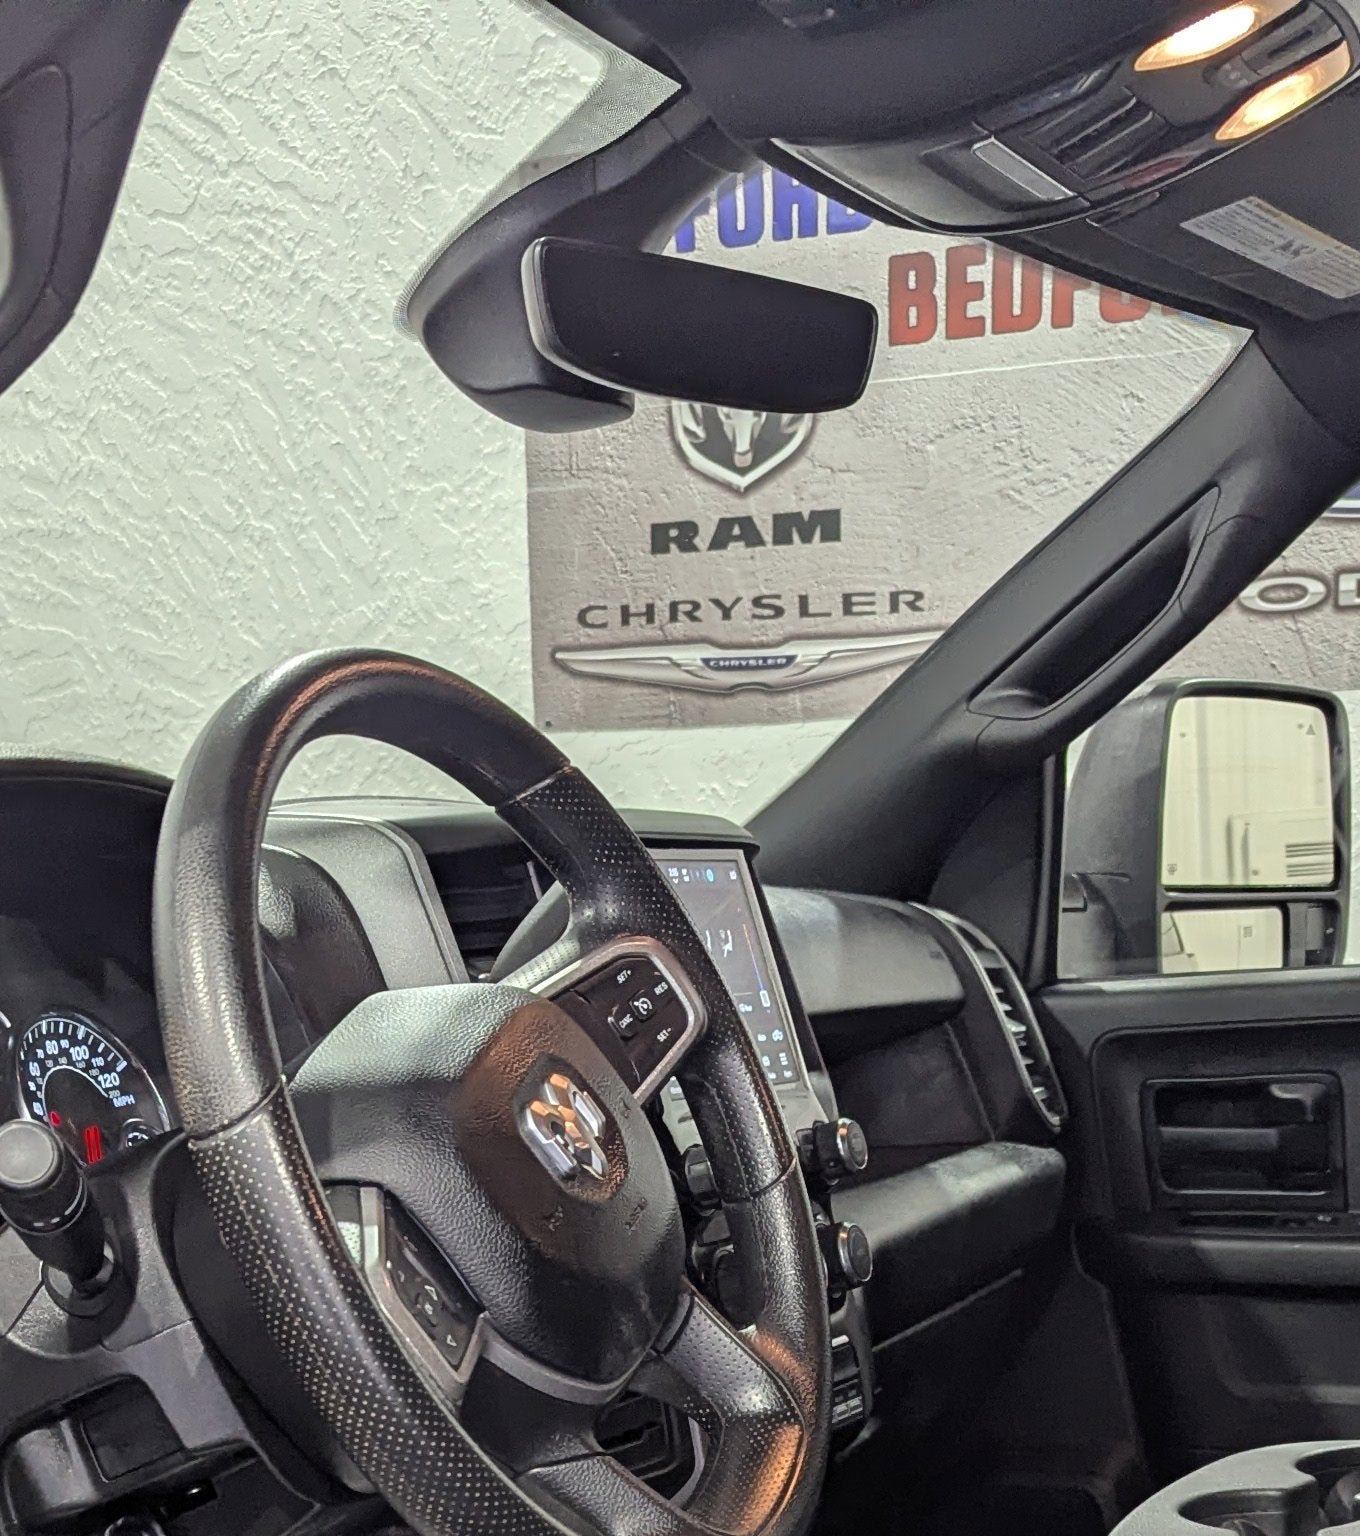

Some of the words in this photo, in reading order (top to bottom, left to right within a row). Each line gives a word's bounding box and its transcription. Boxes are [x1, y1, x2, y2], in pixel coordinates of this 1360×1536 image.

[887, 238, 1188, 347] BEDF
[650, 508, 842, 555] RAM
[577, 589, 926, 630] CHRYSLER
[709, 656, 788, 668] CHRYSLER
[654, 981, 669, 995] RES
[69, 1045, 89, 1061] 100
[98, 1072, 120, 1089] 120
[112, 1094, 136, 1108] MPH
